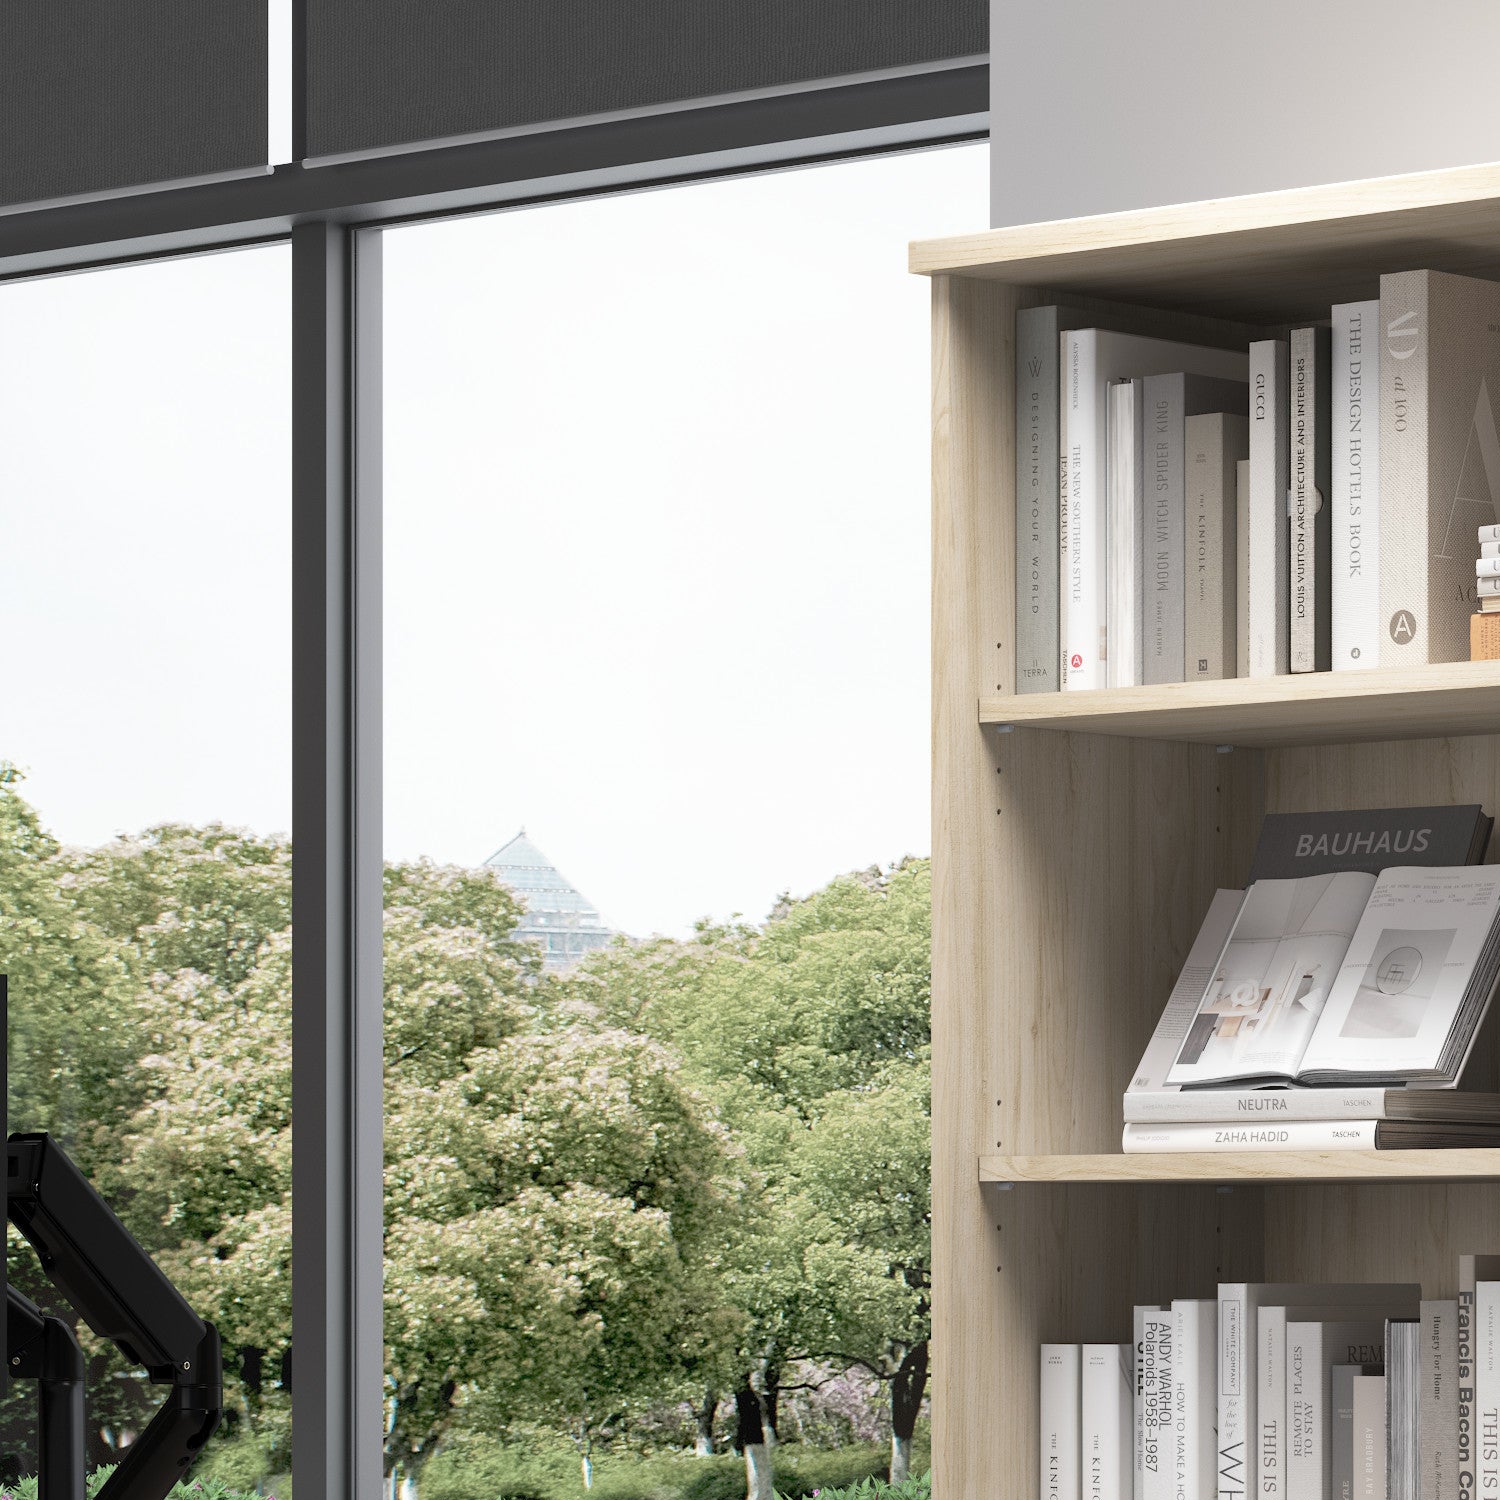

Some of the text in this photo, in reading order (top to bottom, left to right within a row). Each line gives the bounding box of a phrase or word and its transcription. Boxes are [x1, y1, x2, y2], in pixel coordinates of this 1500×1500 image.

[1256, 373, 1266, 421] GUCCI
[1394, 399, 1408, 433] 100
[1349, 313, 1362, 578] THE DESIGN HOTELS BOOK
[1031, 393, 1039, 615] DESIGNING YOUR WORLD
[1156, 400, 1169, 592] MOON WITCH SPIDER KING
[1296, 358, 1305, 619] LOUIS VUITTON ARCHITECTURE AND INTERIORS
[1072, 445, 1082, 604] THE NEW SOUTHERN STYLE
[1198, 514, 1207, 573] KINFOLK
[1022, 668, 1048, 678] TERRA
[1294, 828, 1432, 858] BAUHAUS
[1237, 1098, 1288, 1112] NEUTRA
[1342, 1098, 1373, 1108] TASCHEN
[1215, 1131, 1290, 1143] ZAHA HADID
[1332, 1130, 1361, 1140] TASCHEN
[1145, 1322, 1158, 1387] Polaroids
[1432, 1316, 1442, 1400] Hungry For Home
[1458, 1291, 1474, 1379] Francis
[1159, 1322, 1172, 1431] ANDY WARHOL
[1176, 1382, 1186, 1414] HOW
[1176, 1418, 1186, 1432] TO
[1293, 1345, 1303, 1457] REMOTE PLACES
[1458, 1387, 1474, 1462] Bacon
[1176, 1435, 1186, 1468] MAKE
[1263, 1420, 1278, 1468] THIS
[1304, 1402, 1313, 1458] TO STAY
[1364, 1426, 1374, 1473] BRADBURY
[1482, 1407, 1499, 1461] THIS
[1176, 1471, 1186, 1481] A
[1263, 1474, 1278, 1493] IS
[1482, 1468, 1499, 1489] IS
